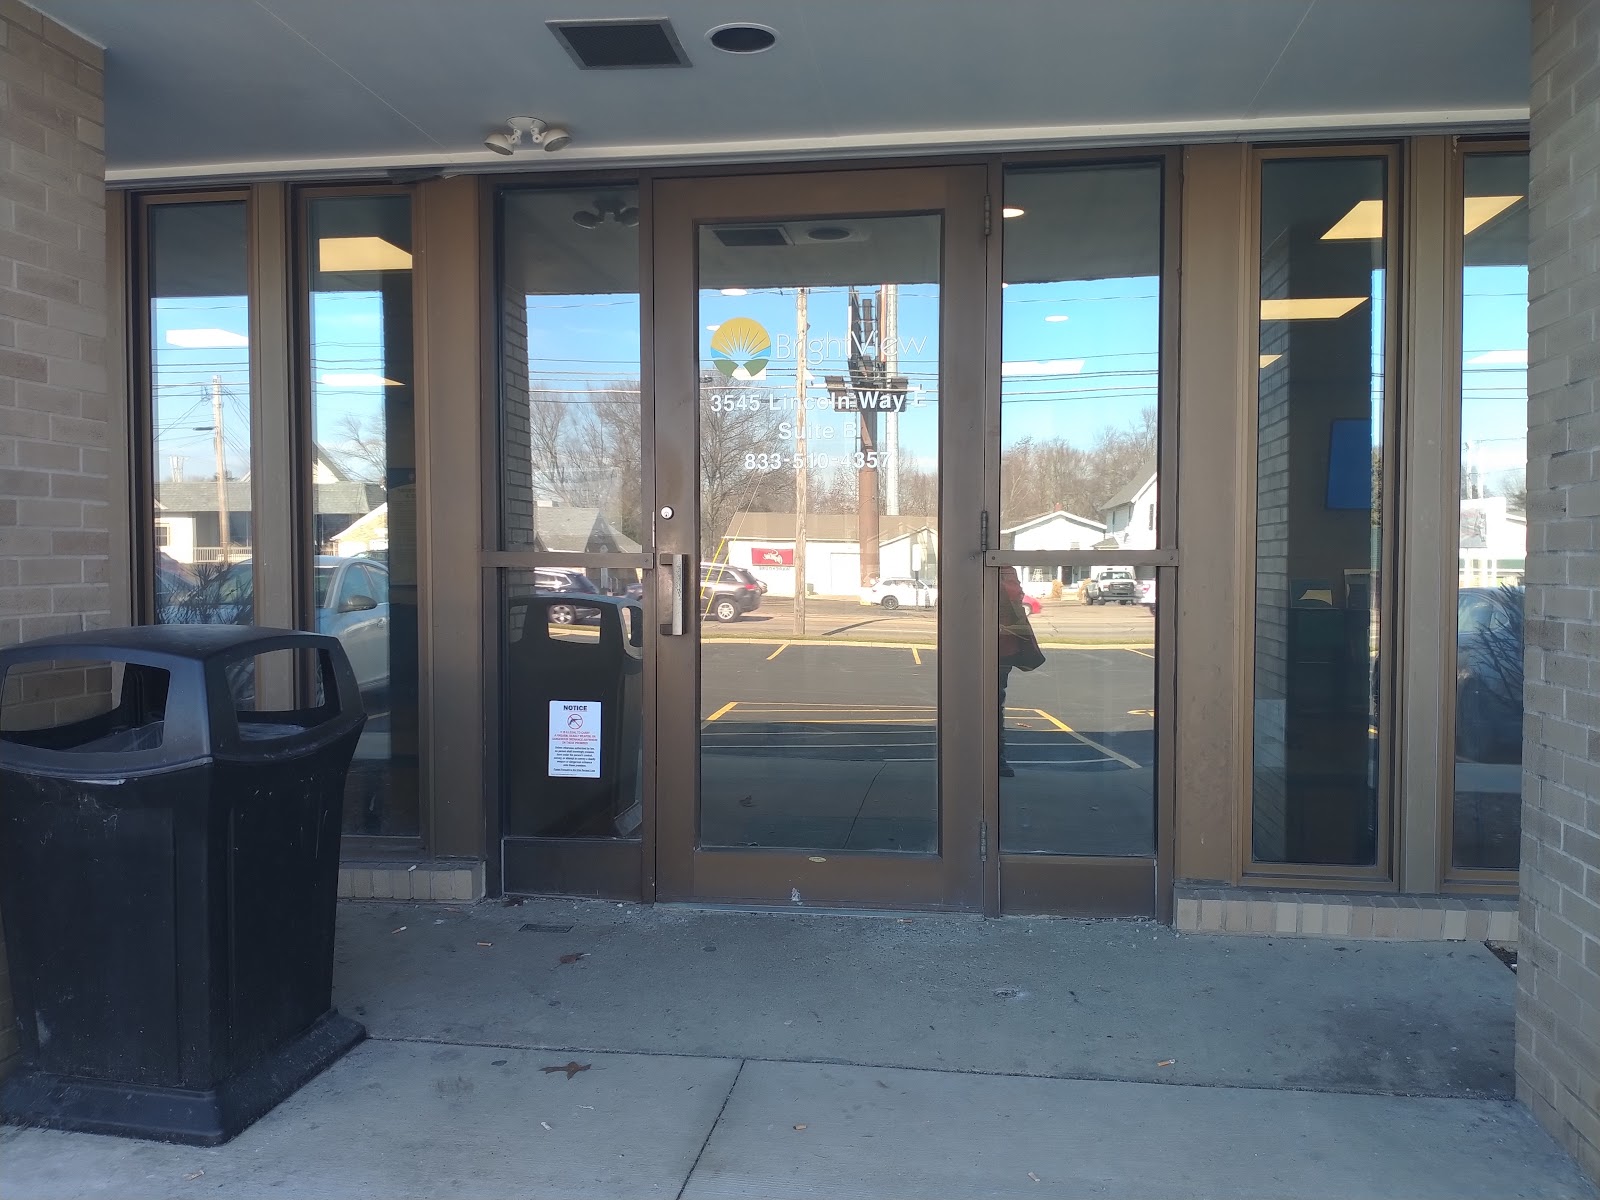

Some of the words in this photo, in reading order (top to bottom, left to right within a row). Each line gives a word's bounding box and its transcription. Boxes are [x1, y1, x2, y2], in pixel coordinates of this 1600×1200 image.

[711, 395, 761, 412] 3545
[769, 392, 850, 411] Lincoln
[858, 391, 904, 412] Way
[778, 422, 835, 440] Suite
[744, 451, 893, 470] 833-510-4357
